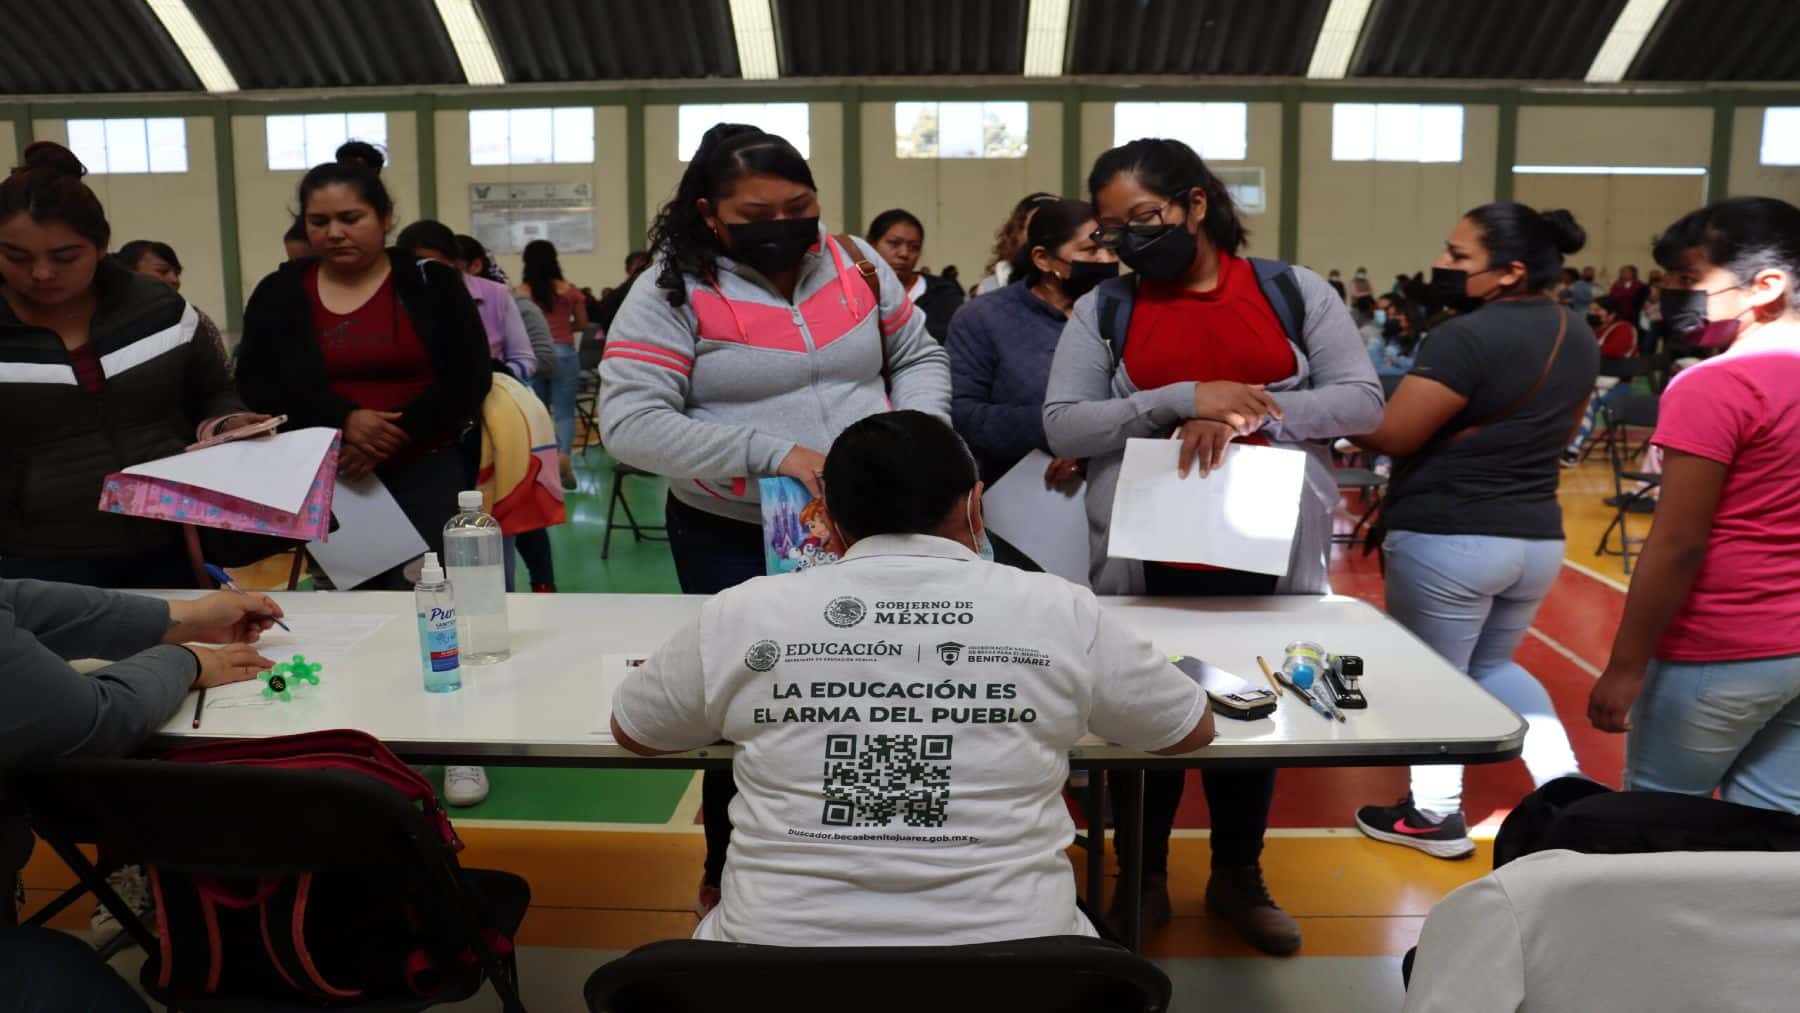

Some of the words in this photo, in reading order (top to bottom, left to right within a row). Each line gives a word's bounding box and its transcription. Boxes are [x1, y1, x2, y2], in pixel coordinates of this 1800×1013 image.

[875, 600, 951, 610] GOBIERNO
[955, 600, 974, 609] DE
[874, 609, 974, 625] MÉXICO
[785, 640, 903, 656] EDUCACIÓN
[967, 655, 1009, 663] BENITO
[1011, 656, 1051, 667] JUÁREZ
[772, 683, 803, 699] LA
[810, 679, 977, 699] EDUCACIÓN
[986, 683, 1017, 699] ES
[753, 708, 777, 724] EL
[782, 706, 861, 723] ARMA
[869, 706, 923, 723] DEL
[931, 707, 1037, 724] PUEBLO
